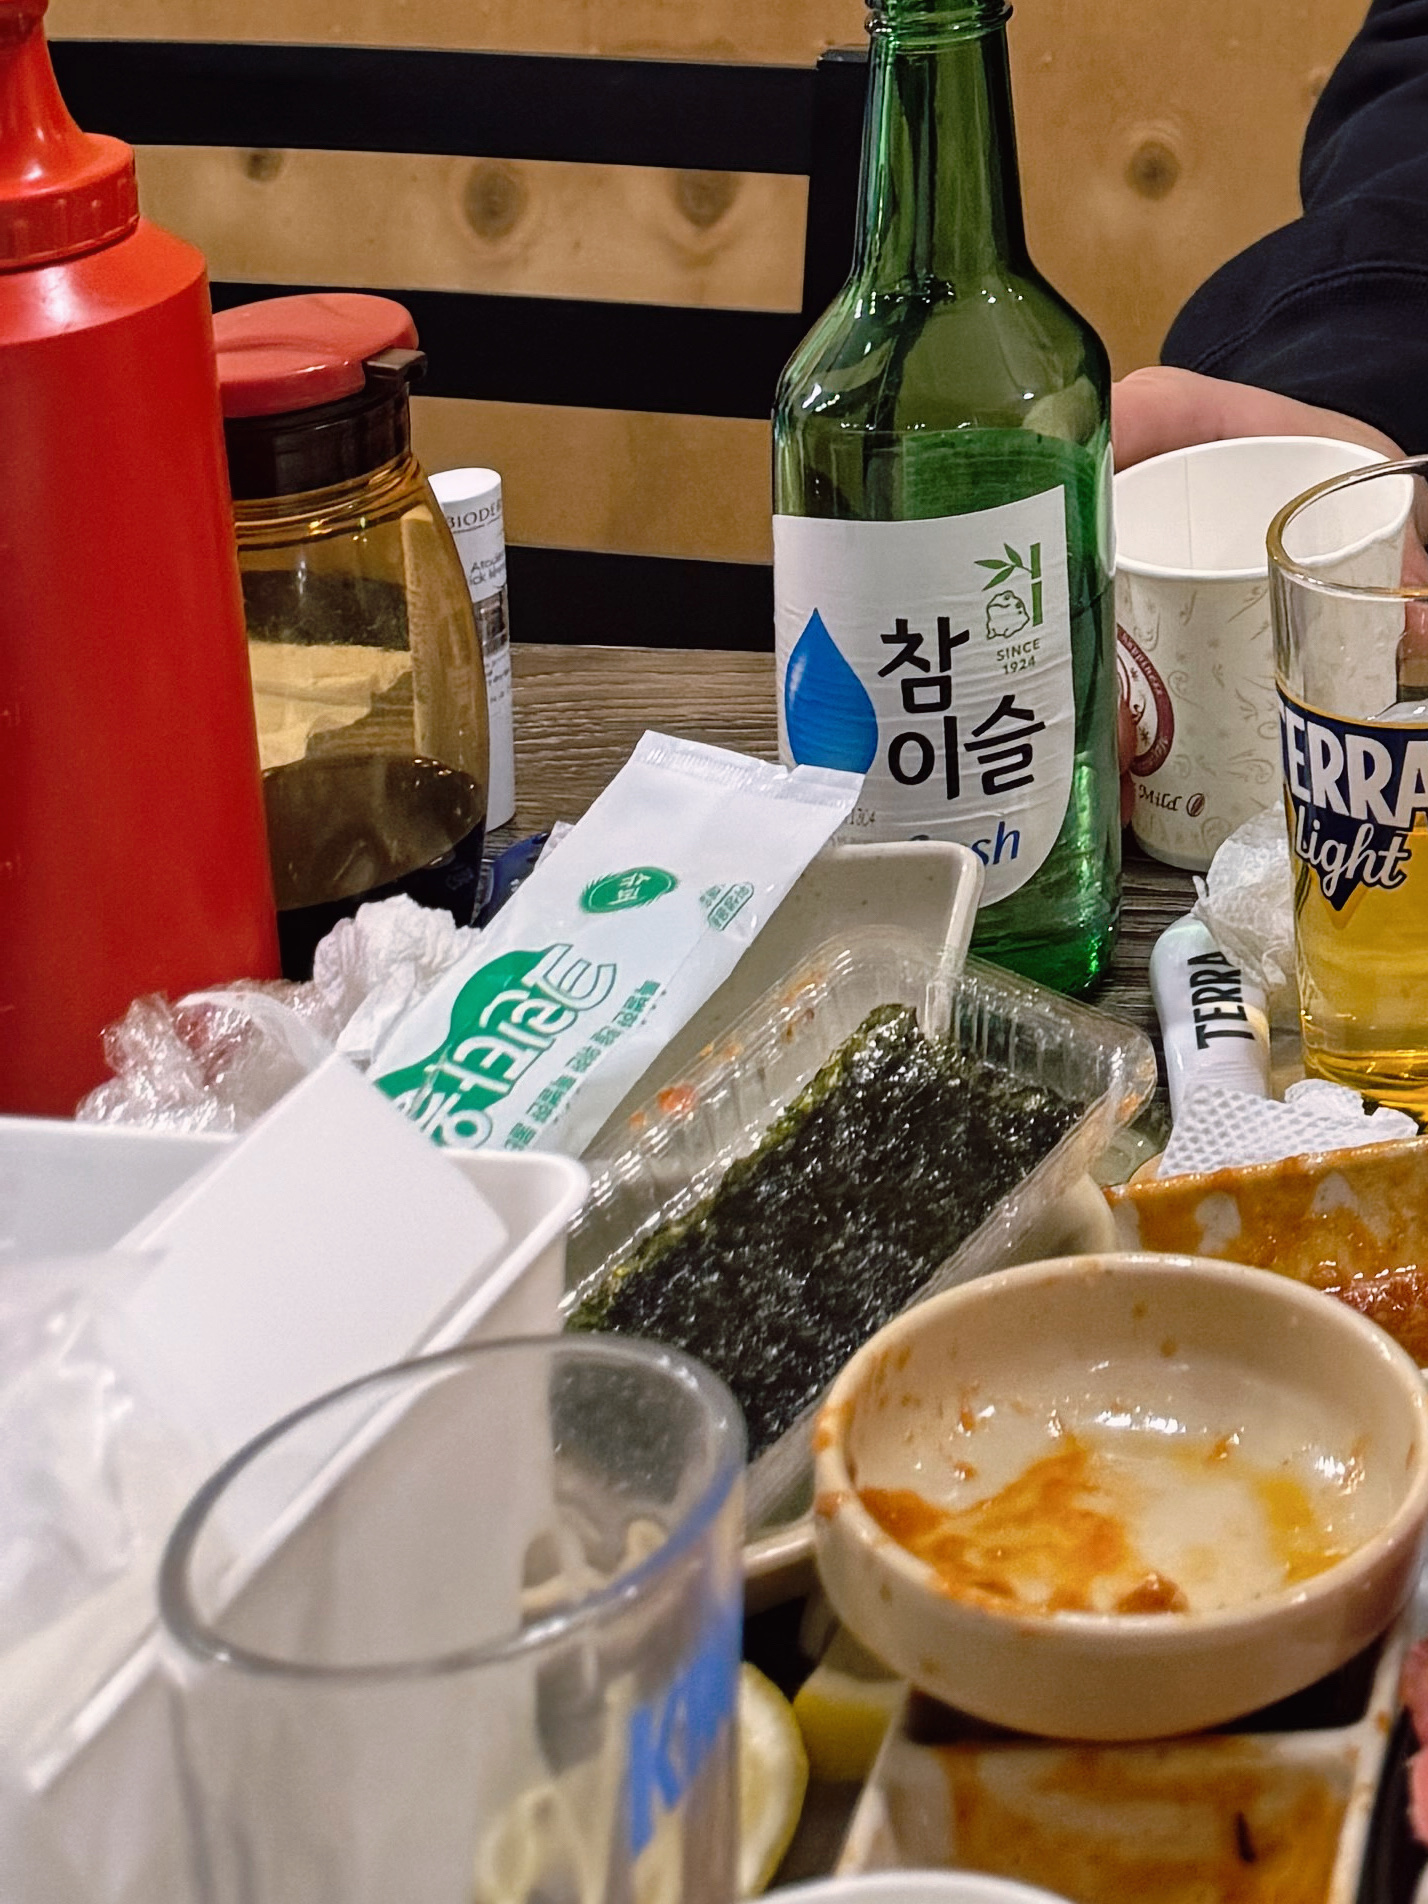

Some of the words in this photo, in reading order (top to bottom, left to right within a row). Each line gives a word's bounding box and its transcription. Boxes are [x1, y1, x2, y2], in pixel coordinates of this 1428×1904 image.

[878, 616, 970, 714] 참
[996, 638, 1041, 662] SINCE
[1003, 655, 1036, 675] 1924
[887, 694, 1046, 800] 이슬
[1138, 783, 1183, 812] Mild
[1296, 804, 1412, 898] Light
[1187, 950, 1256, 1050] TERRA
